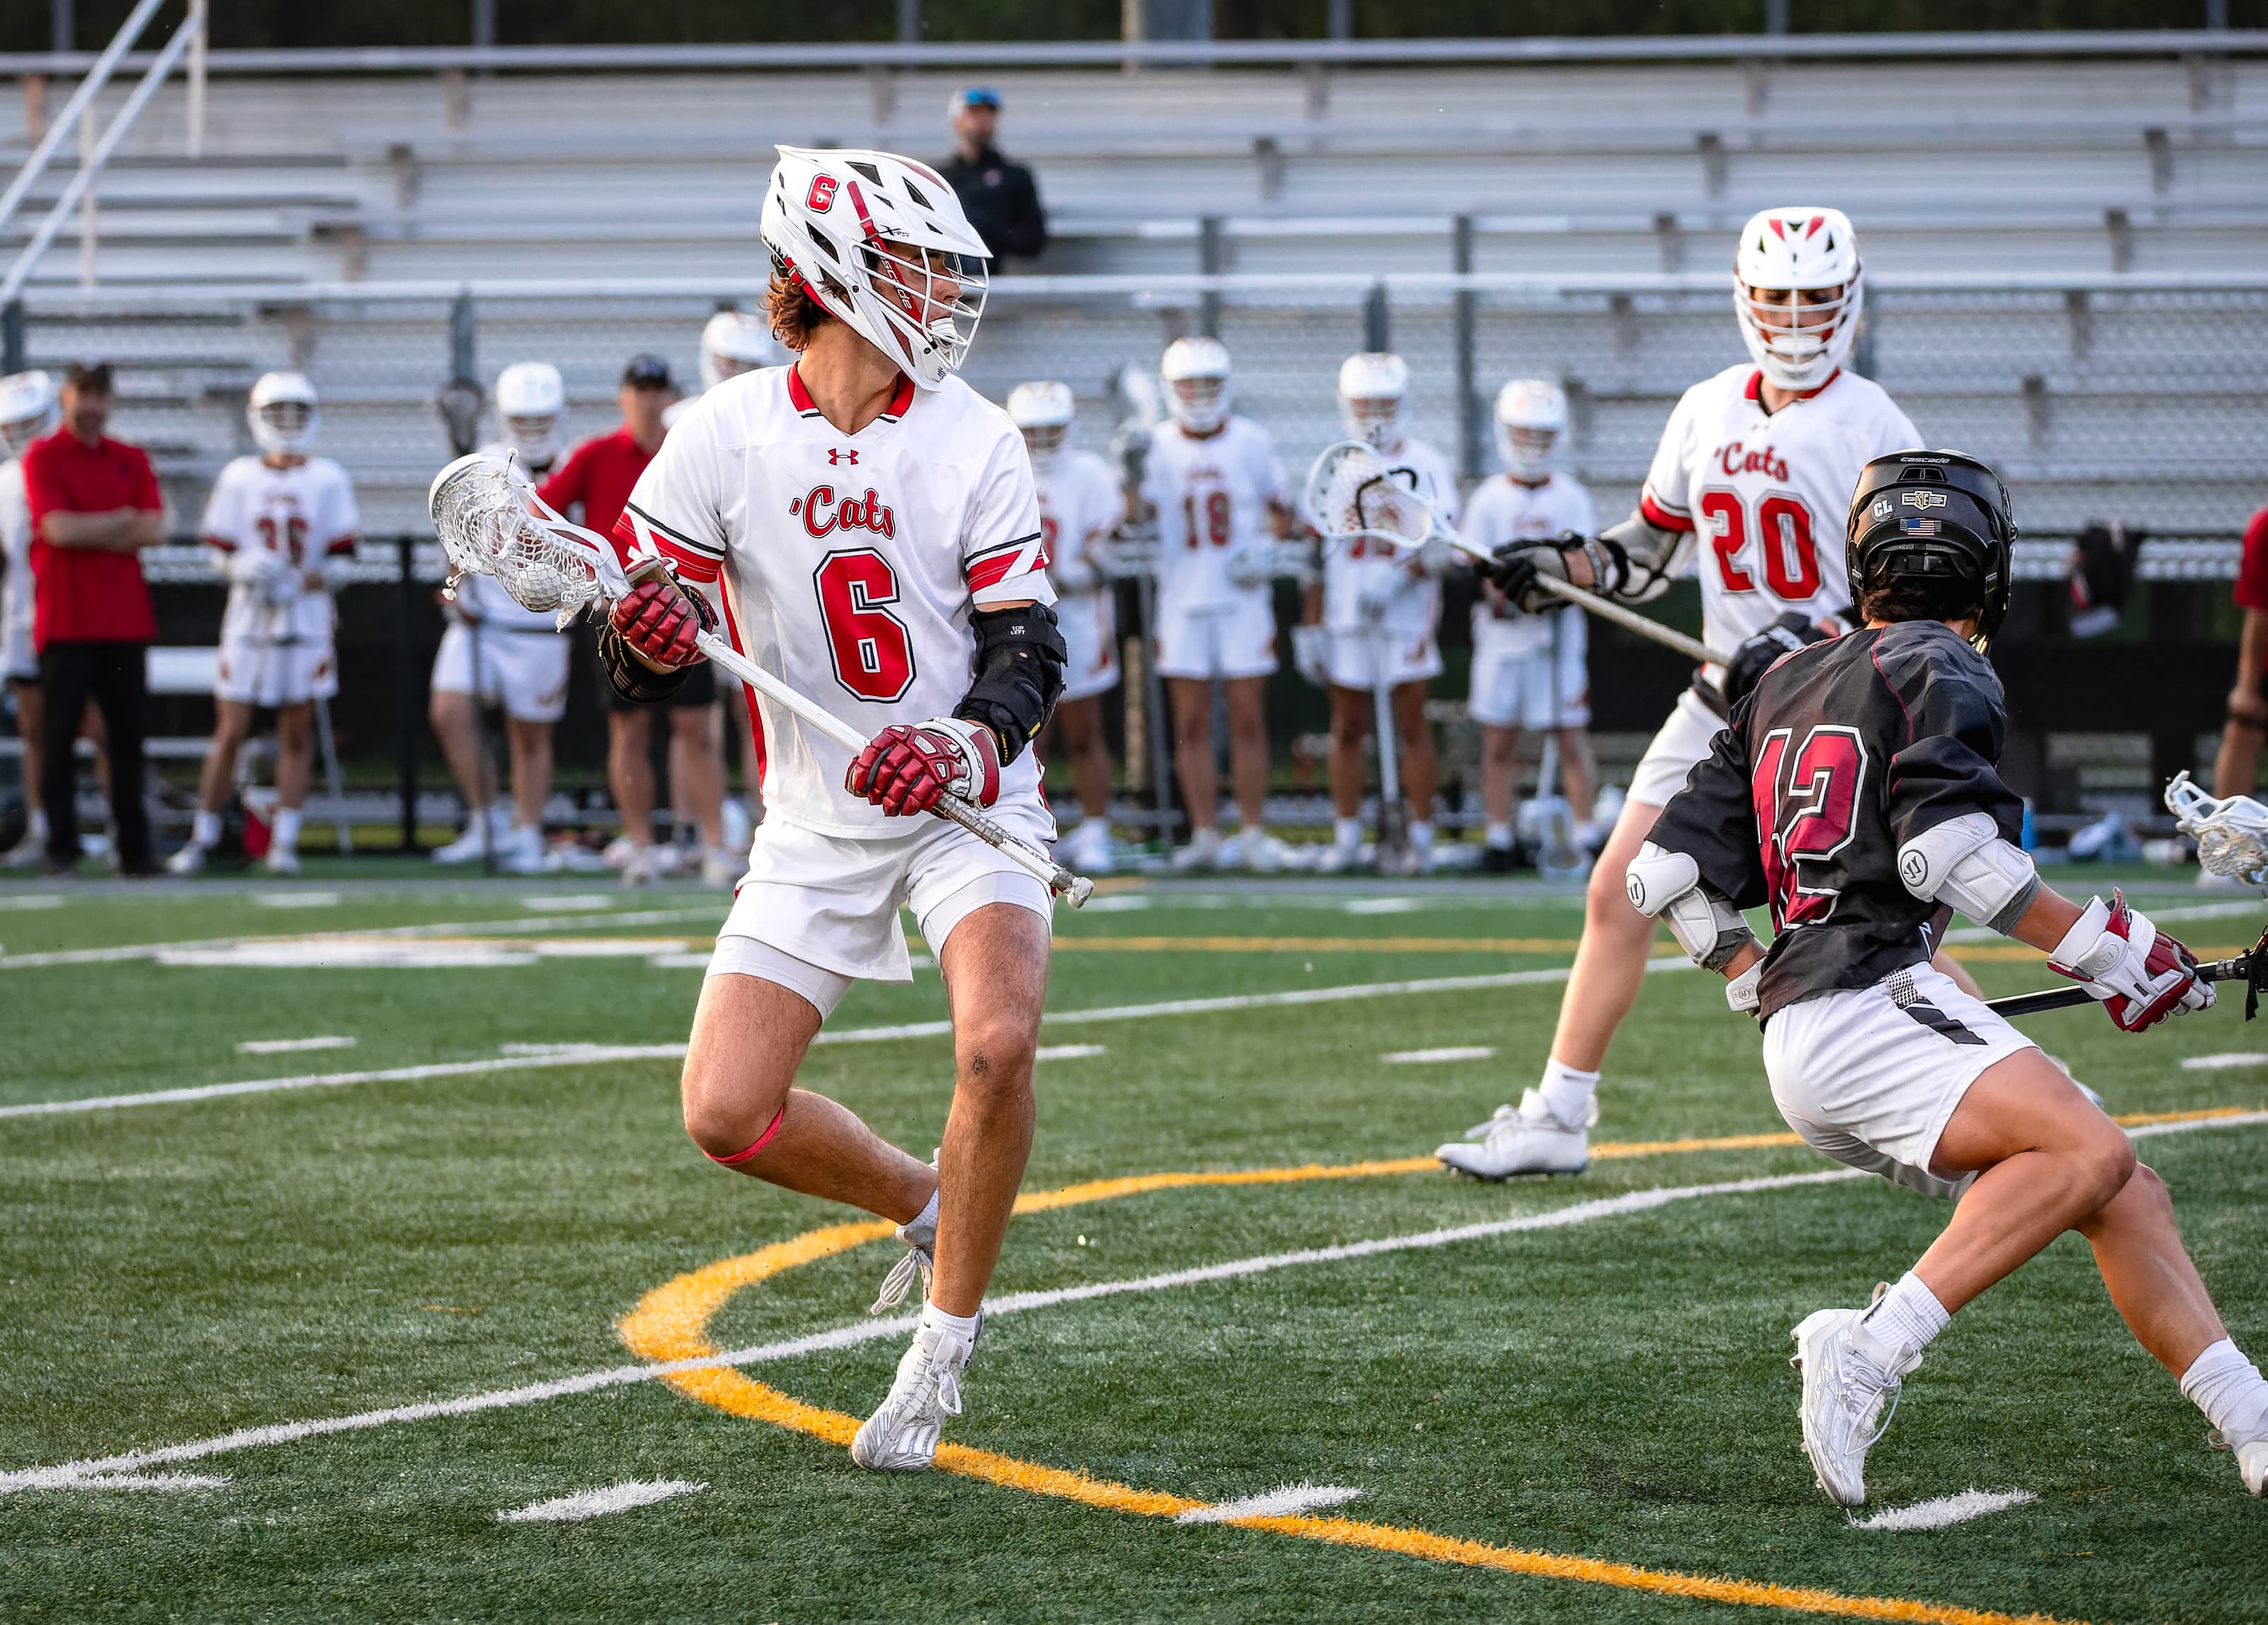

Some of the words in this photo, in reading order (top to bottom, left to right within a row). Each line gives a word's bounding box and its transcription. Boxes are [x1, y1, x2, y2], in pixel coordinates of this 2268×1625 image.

[805, 172, 840, 215] 6
[1698, 484, 1827, 603] 20
[1873, 500, 1894, 517] CL
[813, 546, 917, 704] 6
